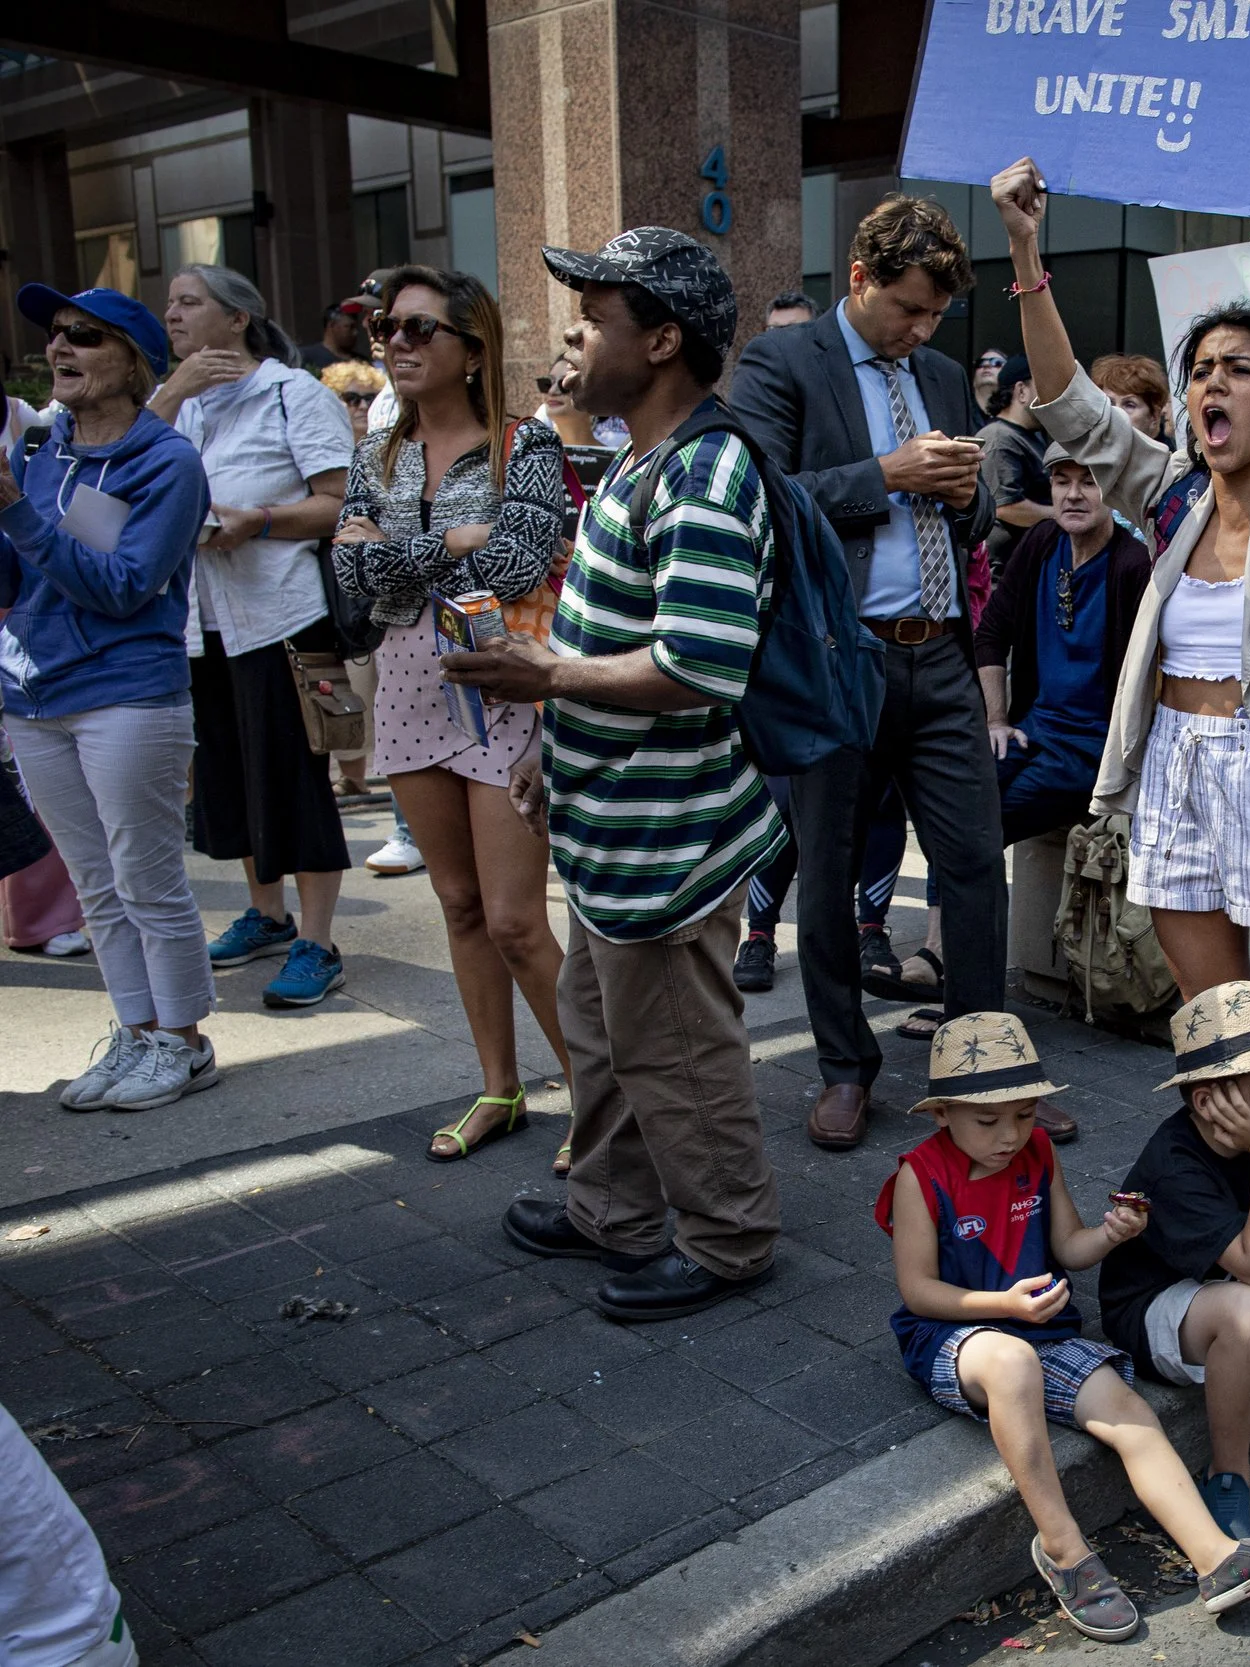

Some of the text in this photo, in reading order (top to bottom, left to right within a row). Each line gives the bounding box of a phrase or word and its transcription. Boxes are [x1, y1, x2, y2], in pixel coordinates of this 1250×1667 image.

[986, 0, 1126, 36] BRAVE
[1034, 72, 1201, 124] UNITE!!
[957, 1219, 984, 1237] AFL
